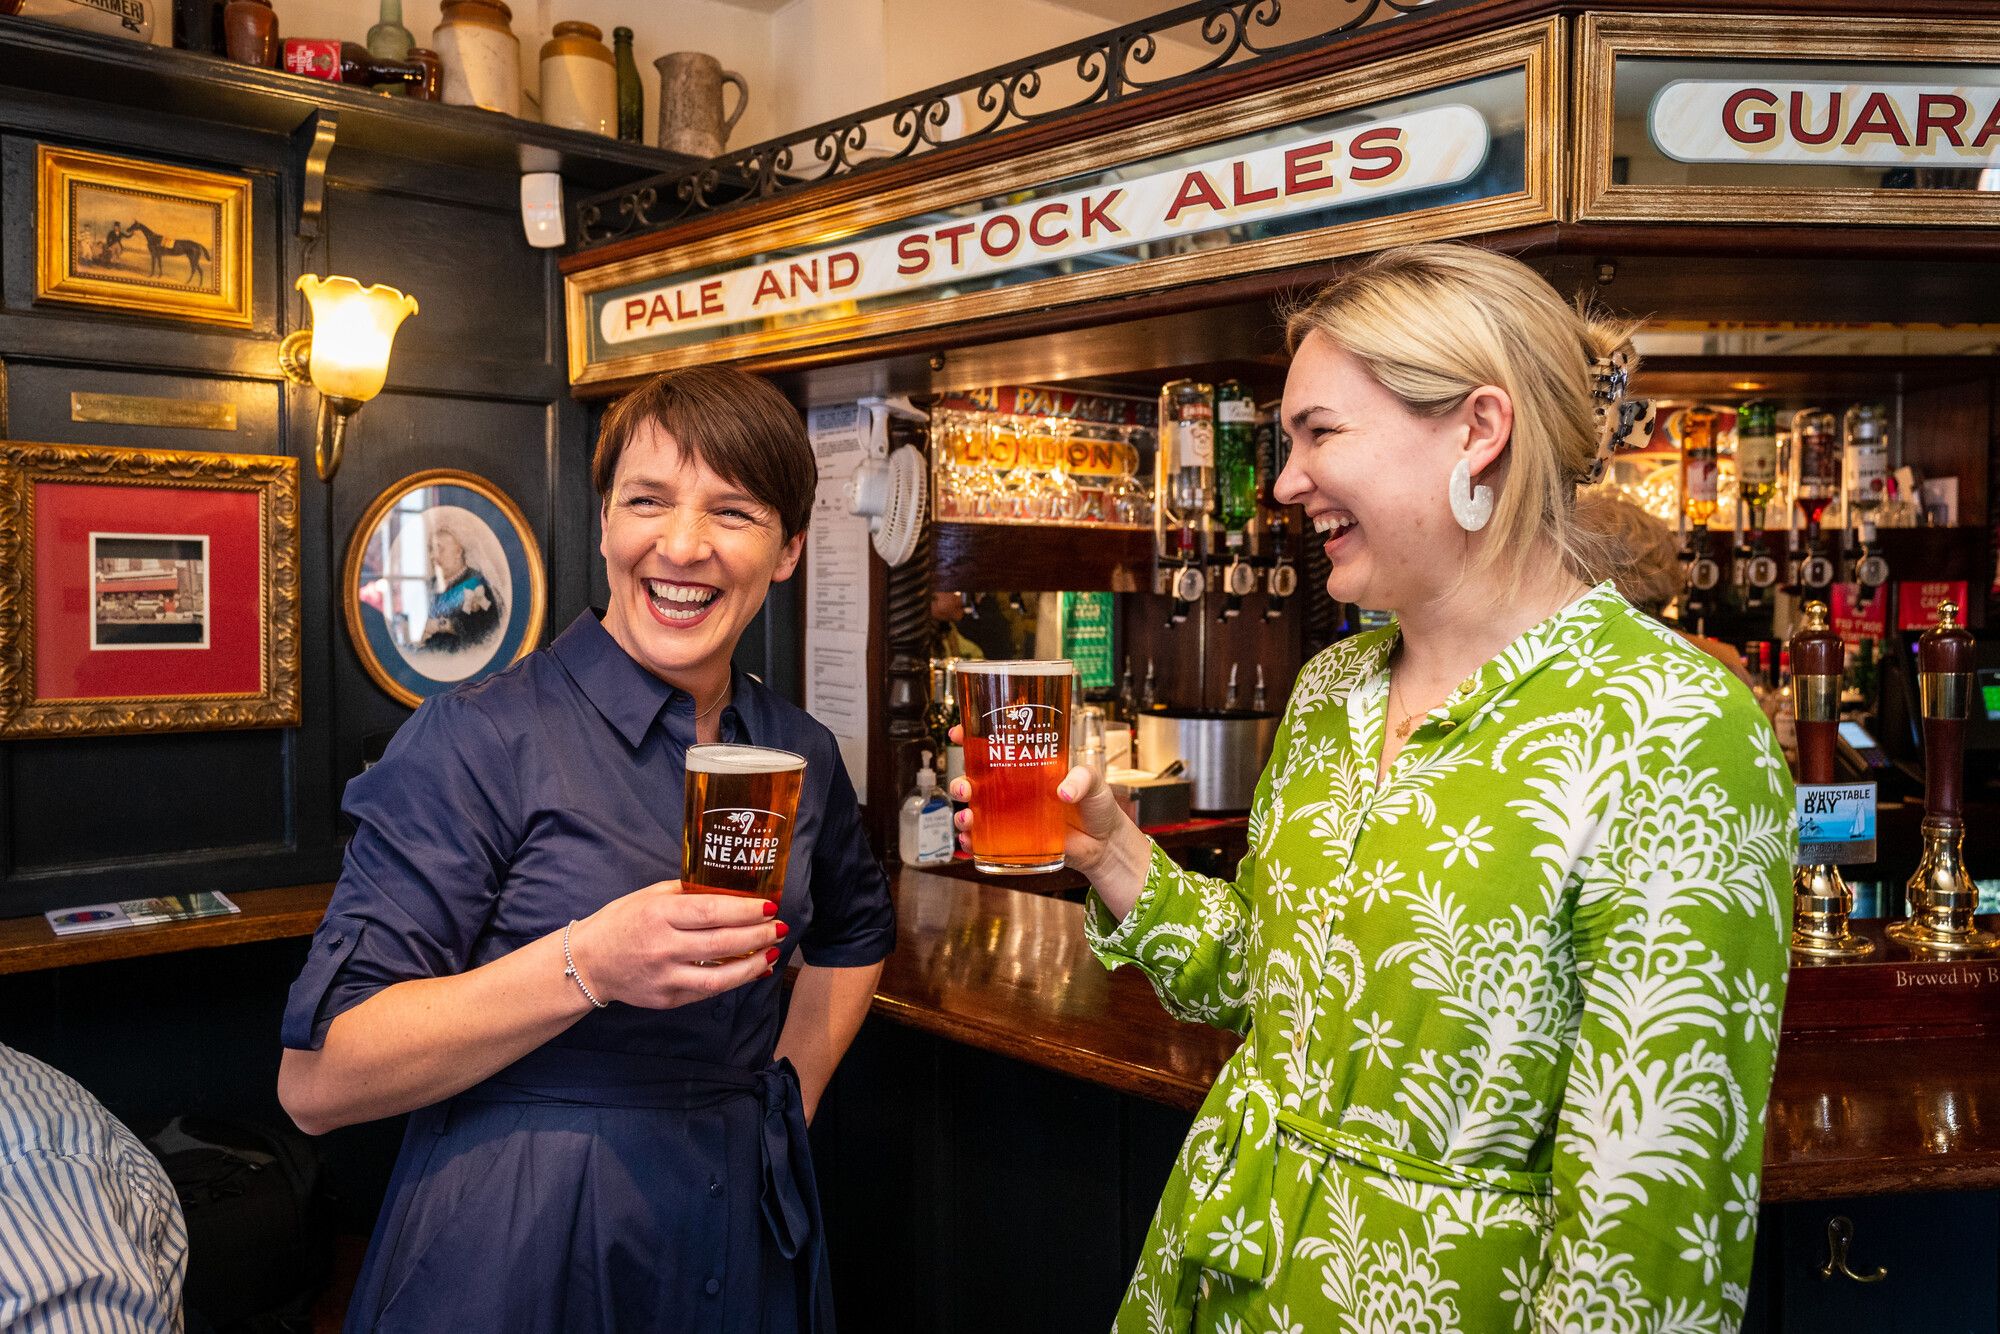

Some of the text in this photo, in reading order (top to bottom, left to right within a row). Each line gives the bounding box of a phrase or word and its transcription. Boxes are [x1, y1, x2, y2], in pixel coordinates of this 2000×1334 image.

[625, 127, 1404, 331] PALE AND STOCK ALES
[988, 732, 1059, 745] SHEPHERD
[988, 743, 1058, 761] NEAME
[1807, 789, 1871, 801] WHITSTABLE
[1804, 798, 1838, 814] BAY
[713, 824, 736, 832] SINCE
[705, 832, 779, 848] SHEPHERD
[704, 843, 777, 864] NEAME
[703, 861, 731, 870] BRITAIN'S
[1896, 967, 1958, 987] Brewed
[1962, 967, 1982, 988] by
